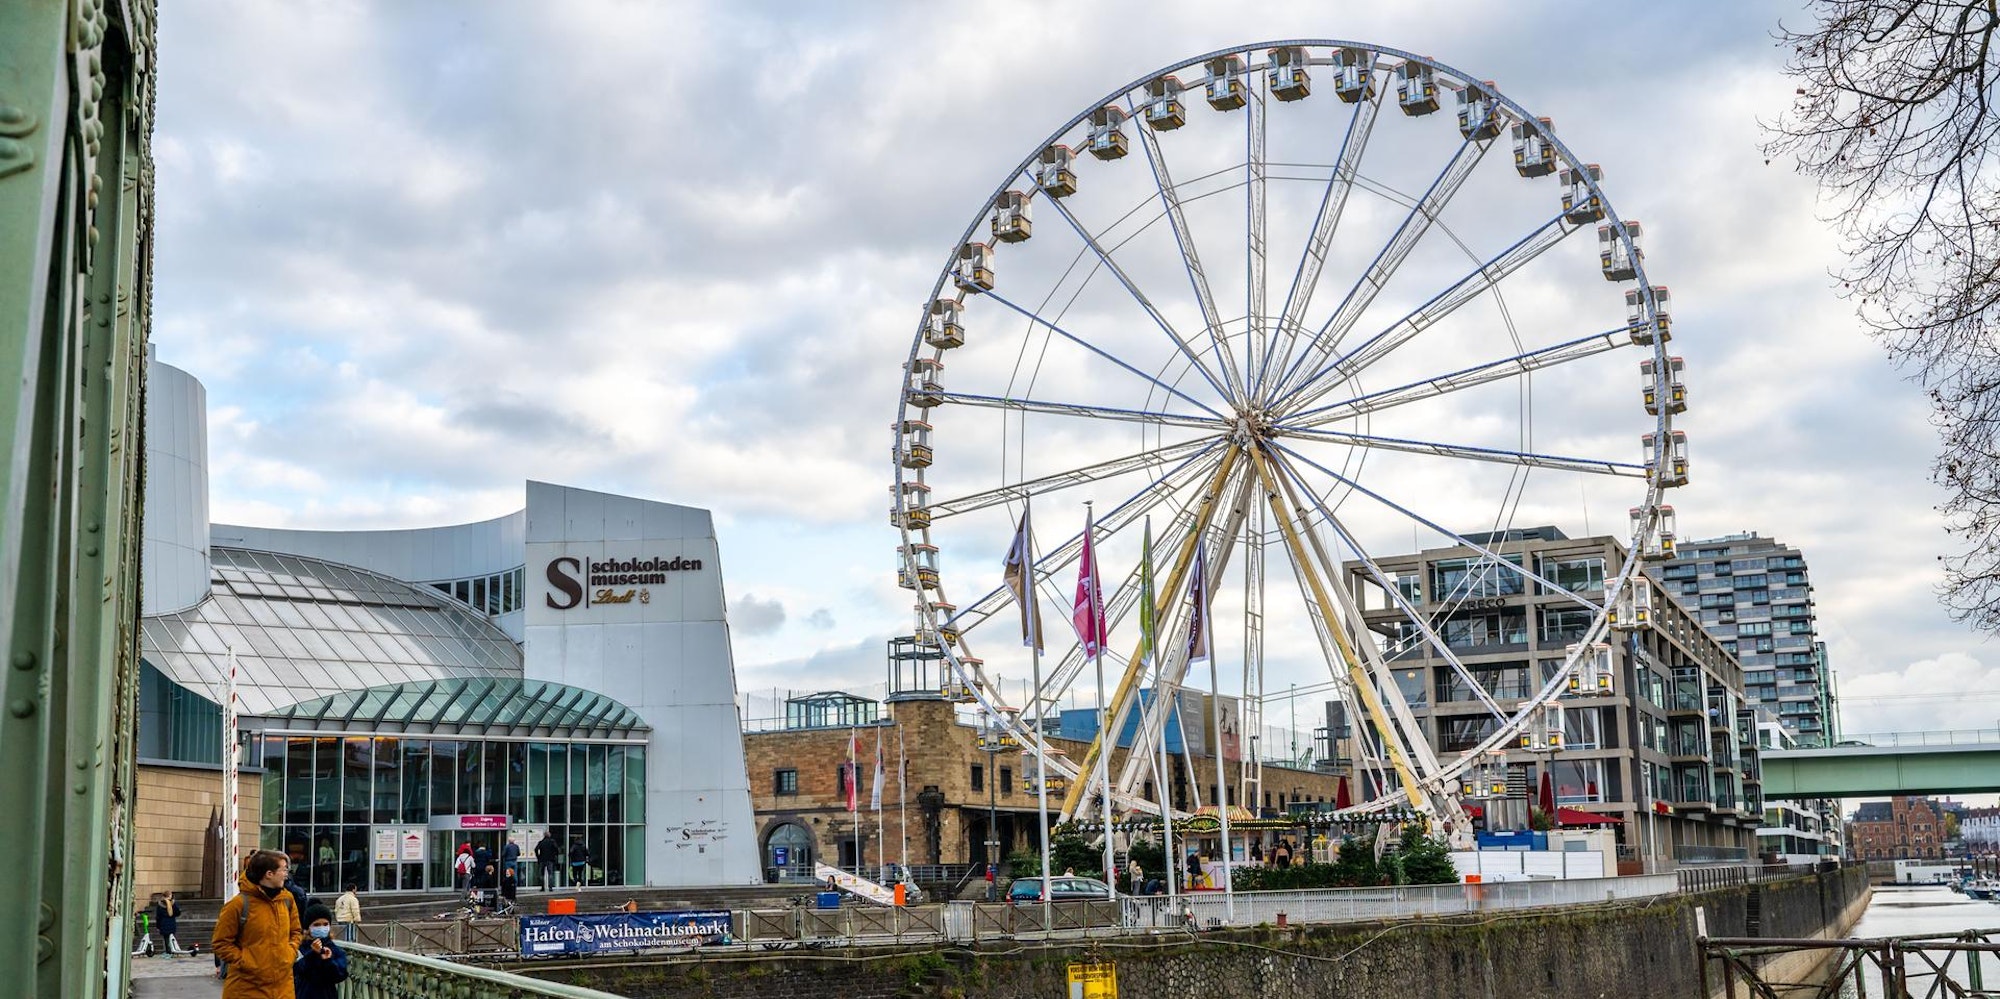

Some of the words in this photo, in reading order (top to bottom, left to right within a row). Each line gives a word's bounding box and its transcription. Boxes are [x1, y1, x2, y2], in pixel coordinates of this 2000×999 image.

[591, 555, 703, 574] schokoladen
[546, 556, 583, 610] S
[591, 571, 666, 586] museum
[591, 588, 637, 604] Lindt
[525, 925, 575, 942] Hafen
[594, 920, 730, 939] Weihnachtsmarkt
[614, 938, 699, 948] Schokoladenmuseum
